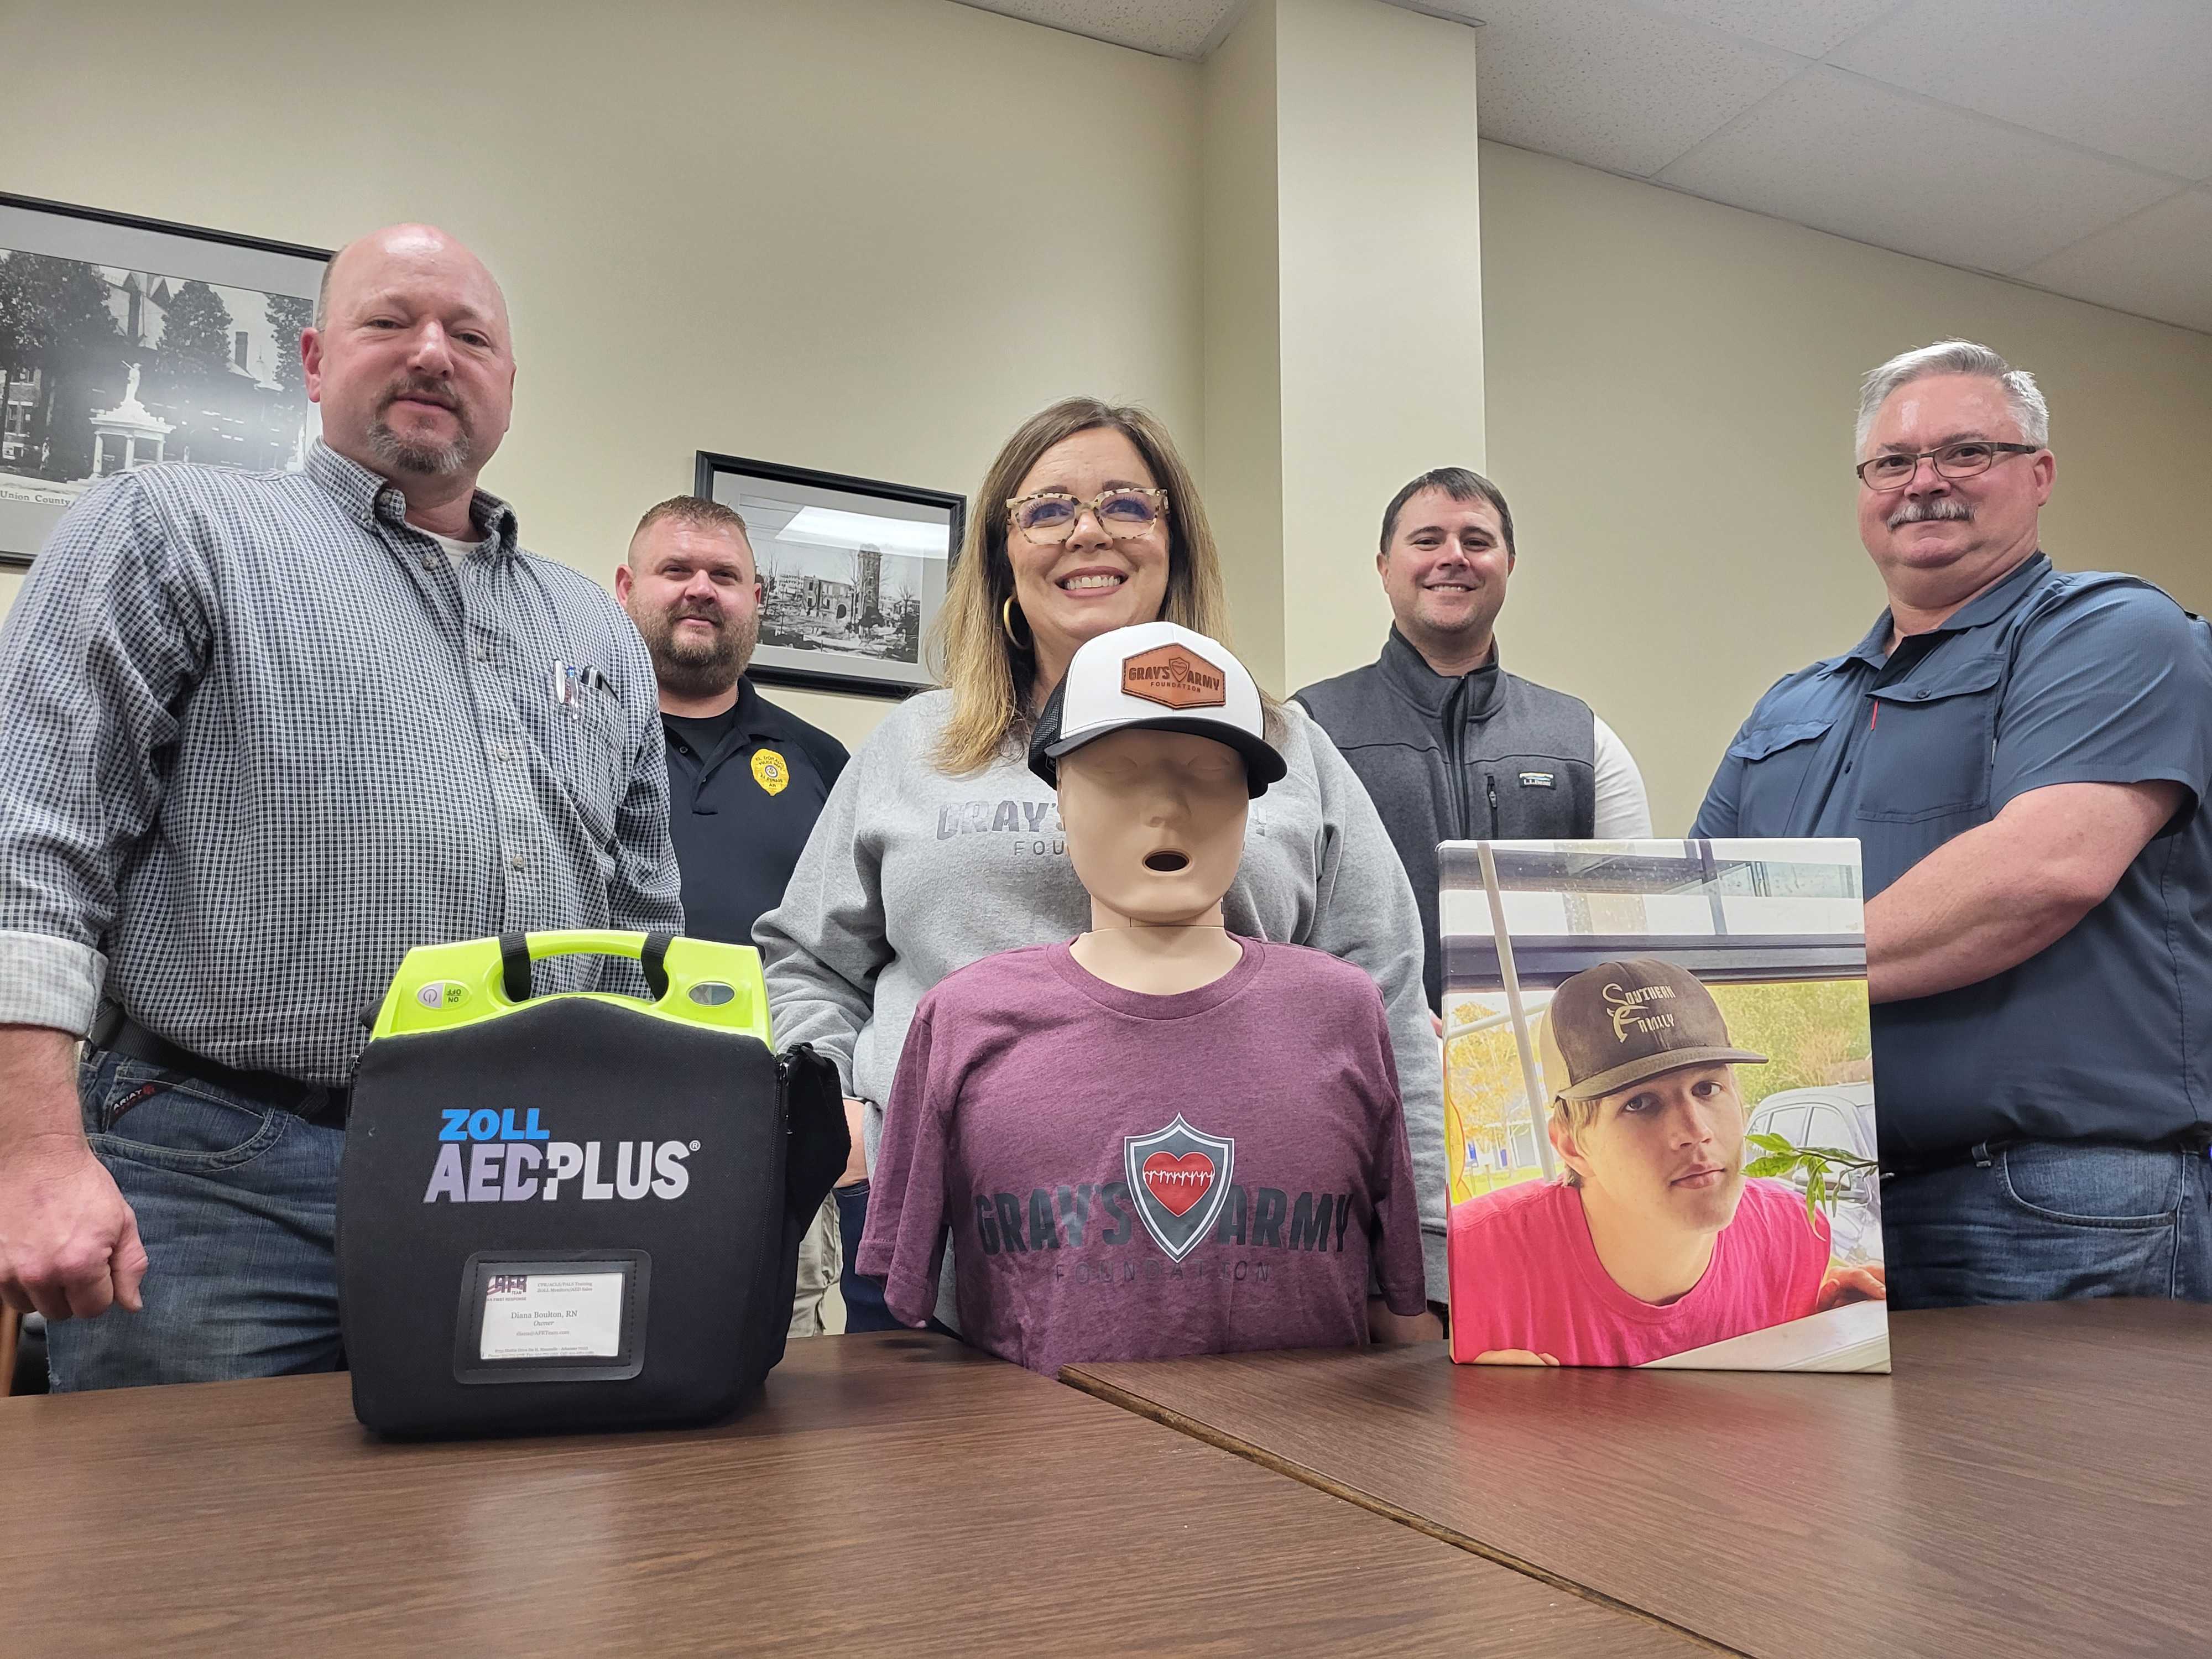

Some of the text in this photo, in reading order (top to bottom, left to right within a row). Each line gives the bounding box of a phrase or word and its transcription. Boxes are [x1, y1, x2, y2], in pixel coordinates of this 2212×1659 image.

[0, 490, 70, 507] Union County
[1129, 666, 1220, 691] GRAY'S ARMY
[1150, 681, 1201, 693] FOUNDATION
[1014, 840, 1064, 855] FOU
[113, 1089, 142, 1110] ARIAT
[439, 1108, 550, 1141] ZOLL
[1216, 1183, 1354, 1253] ARMY
[1056, 1259, 1270, 1283] FOUNDATION
